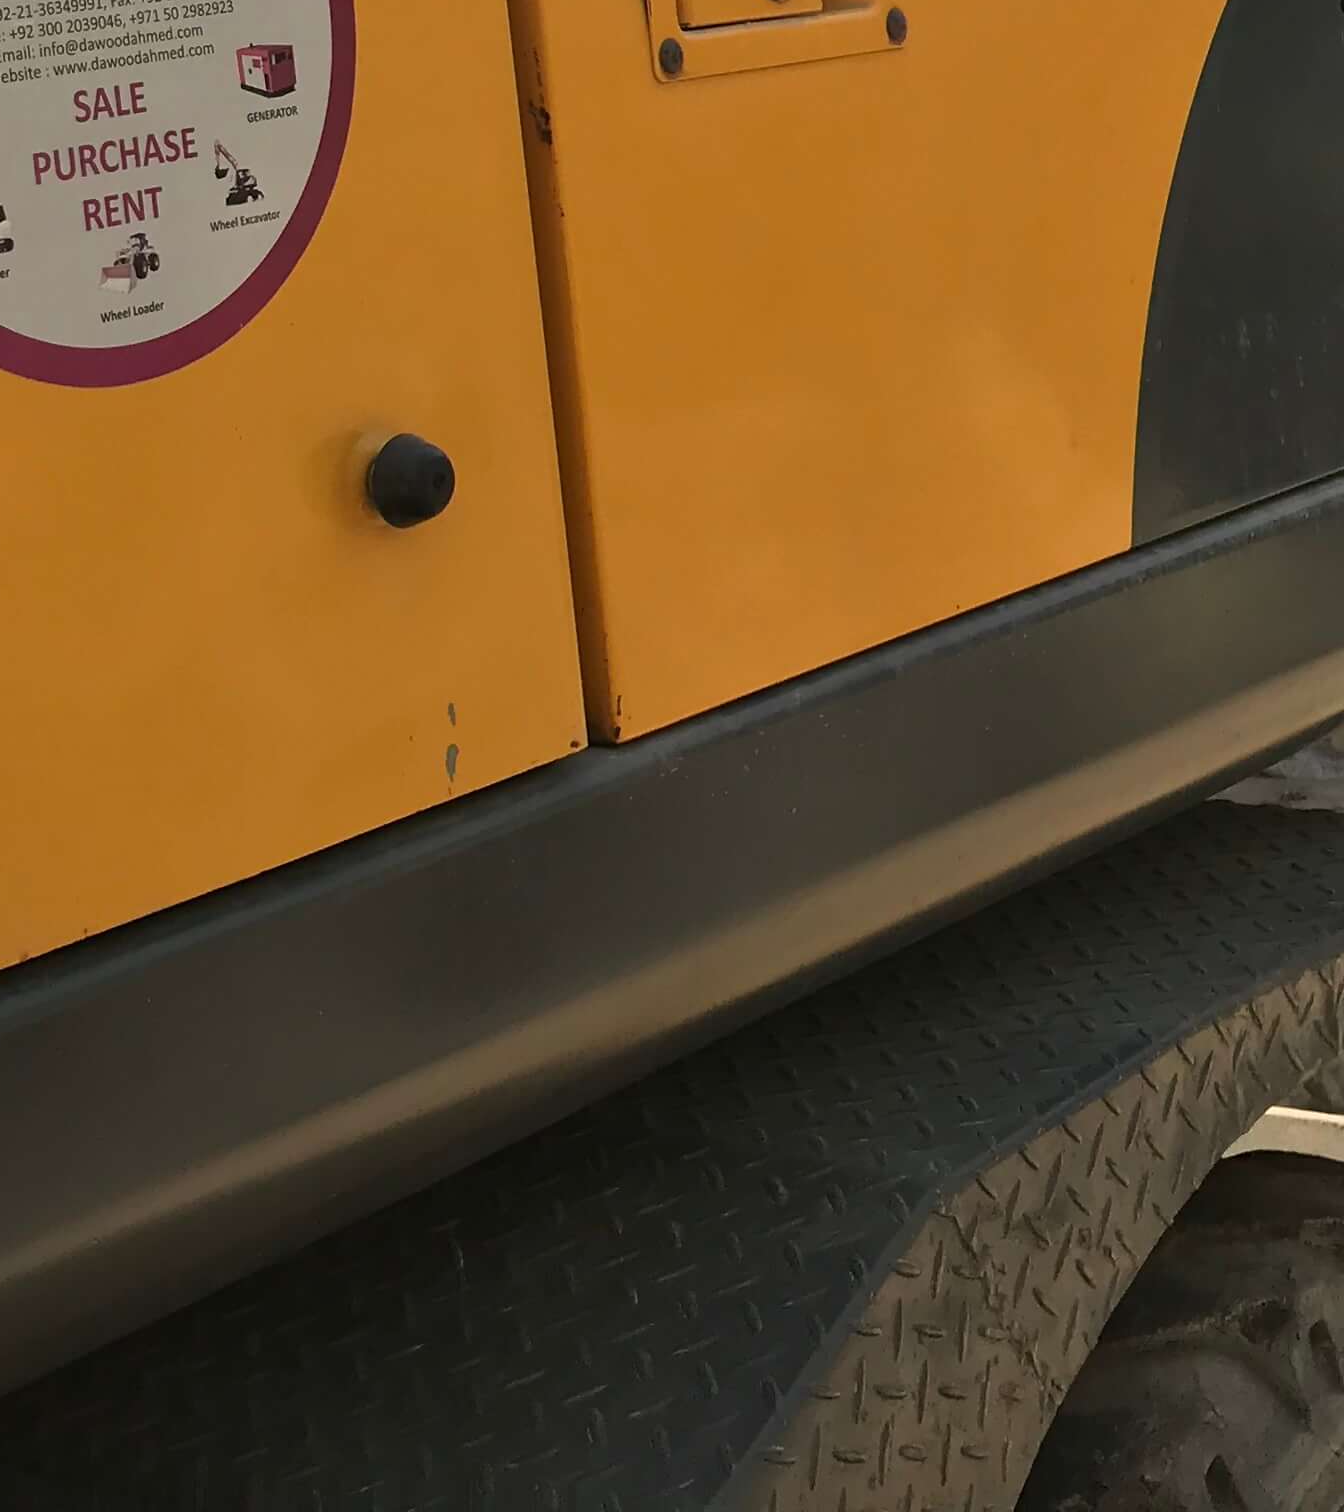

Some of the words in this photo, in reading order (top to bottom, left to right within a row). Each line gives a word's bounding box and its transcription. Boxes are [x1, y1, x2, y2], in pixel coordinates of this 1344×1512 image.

[9, 24, 34, 40] +92
[38, 21, 63, 37] 300
[67, 13, 126, 34] 2039046,
[129, 8, 159, 26] +971
[164, 5, 179, 21] 50
[182, 0, 234, 19] 2982923
[39, 24, 204, 57] info@dawoodahmed.com
[53, 42, 215, 77] www.dawoodahmed.com
[72, 81, 148, 123] SALE
[246, 105, 299, 124] GENERATOR
[32, 127, 199, 185] PURCHASE
[82, 186, 164, 232] RENT
[209, 216, 240, 233] Wheel
[241, 209, 281, 228] Excavator
[100, 307, 131, 324] Wheel
[132, 299, 165, 318] Loader
